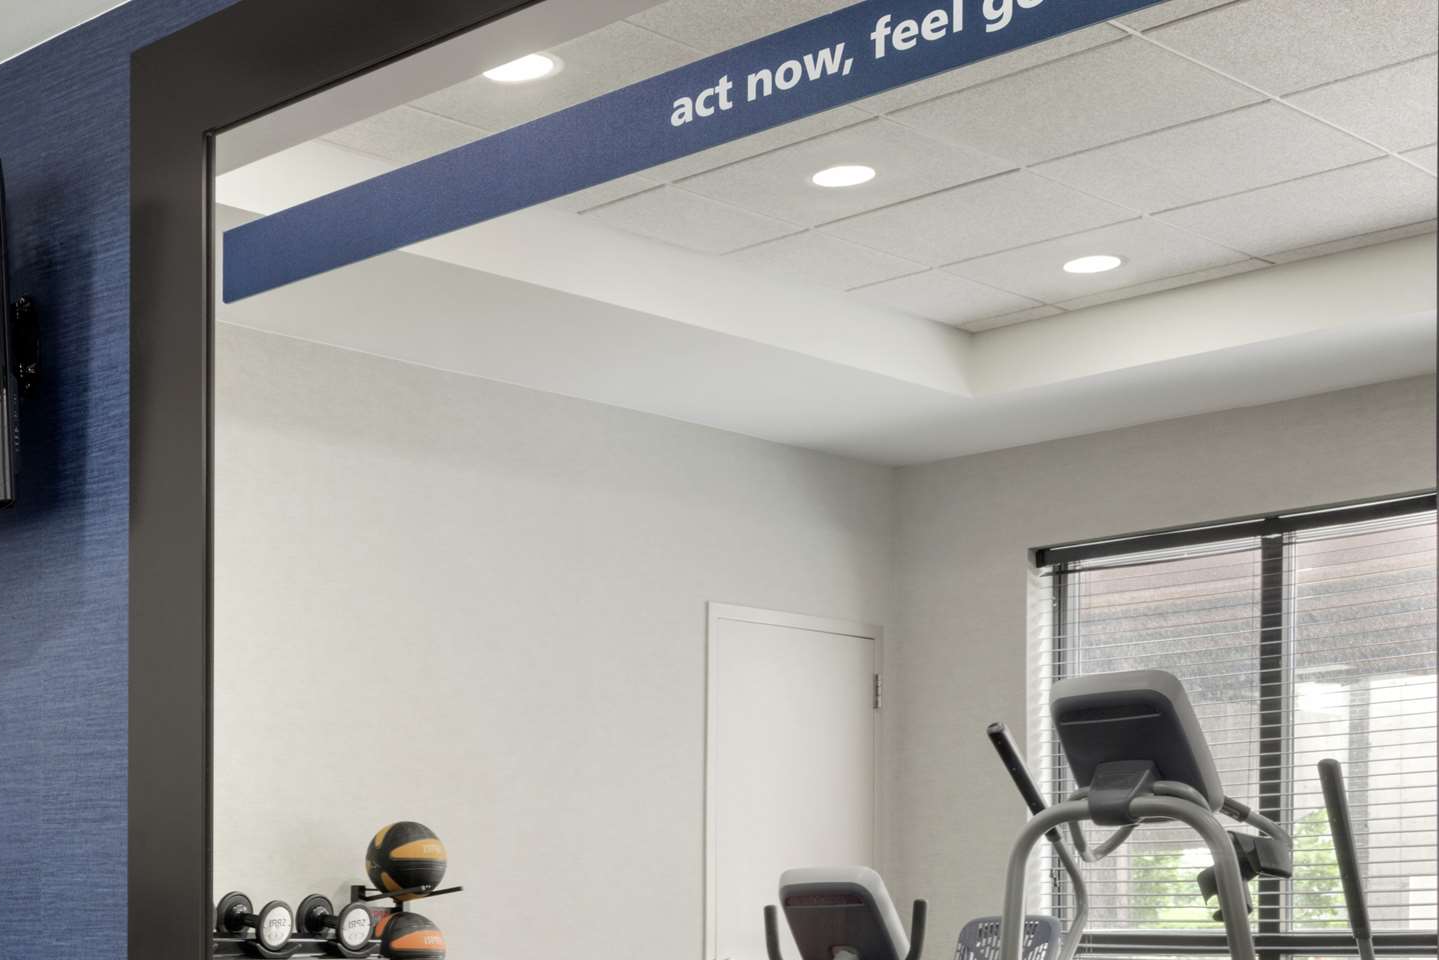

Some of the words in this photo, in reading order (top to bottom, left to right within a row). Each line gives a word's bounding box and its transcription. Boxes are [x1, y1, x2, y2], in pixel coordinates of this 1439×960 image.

[670, 74, 733, 127] act
[747, 42, 854, 102] now,
[870, 0, 964, 59] feel
